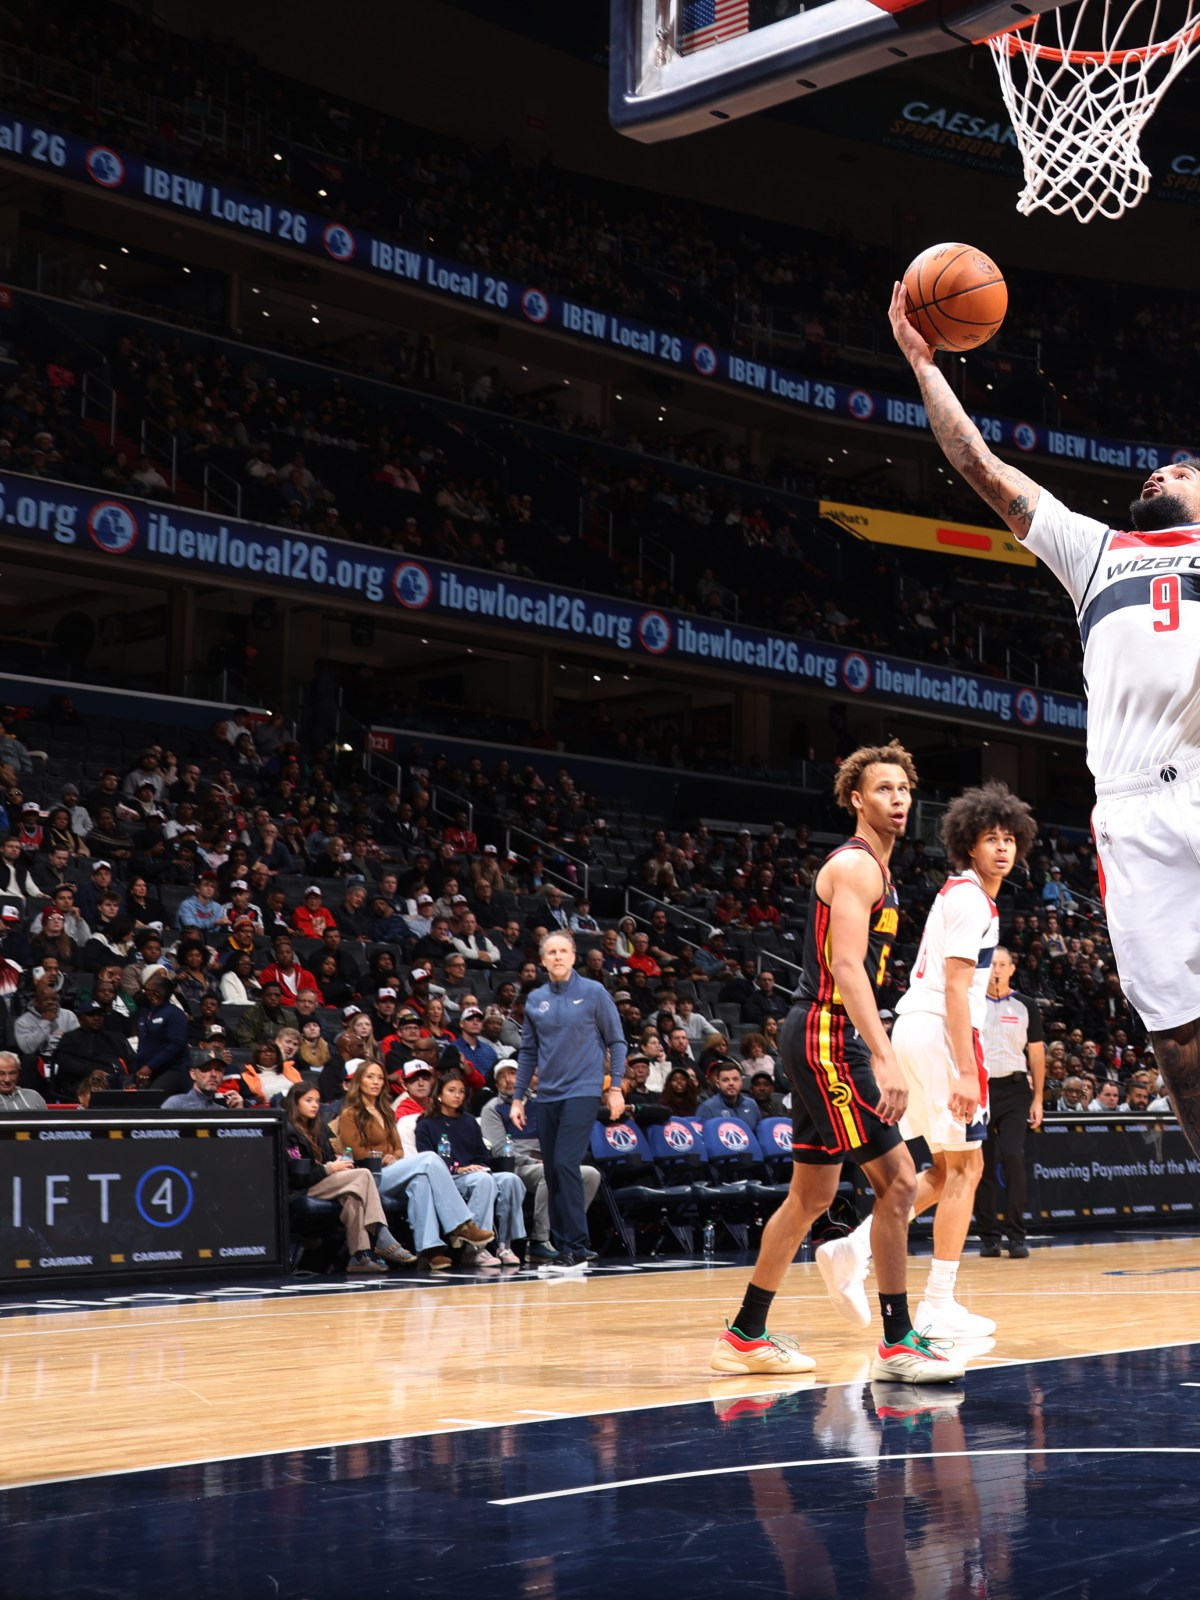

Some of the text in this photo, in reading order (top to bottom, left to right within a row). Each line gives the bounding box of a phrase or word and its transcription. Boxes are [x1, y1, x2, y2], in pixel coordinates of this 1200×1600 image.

[31, 127, 67, 168] 26
[890, 119, 1006, 158] SPORTSBOOK
[902, 101, 1018, 147] CAESAR
[143, 164, 308, 247] IBEW Local 26
[370, 239, 509, 309] IBEW Local 26
[562, 301, 682, 364] IBEW Local 26
[728, 355, 836, 411] IBEW Local 26
[887, 399, 928, 428] IBEW
[982, 418, 1002, 443] 26
[1049, 431, 1158, 469] IBEW Local 26
[147, 513, 385, 601] ibewlocal26.org
[439, 570, 632, 651] ibewlocal26.org
[1151, 574, 1181, 633] 9
[676, 622, 838, 688] ibewlocal26.org
[875, 658, 1012, 722] ibewlocal26.org
[371, 737, 389, 750] 121
[876, 944, 891, 986] 5
[1034, 1163, 1090, 1182] Powering
[1092, 1161, 1148, 1181] Payments
[1149, 1158, 1165, 1175] for
[1167, 1158, 1185, 1175] the
[13, 1173, 121, 1228] IFT
